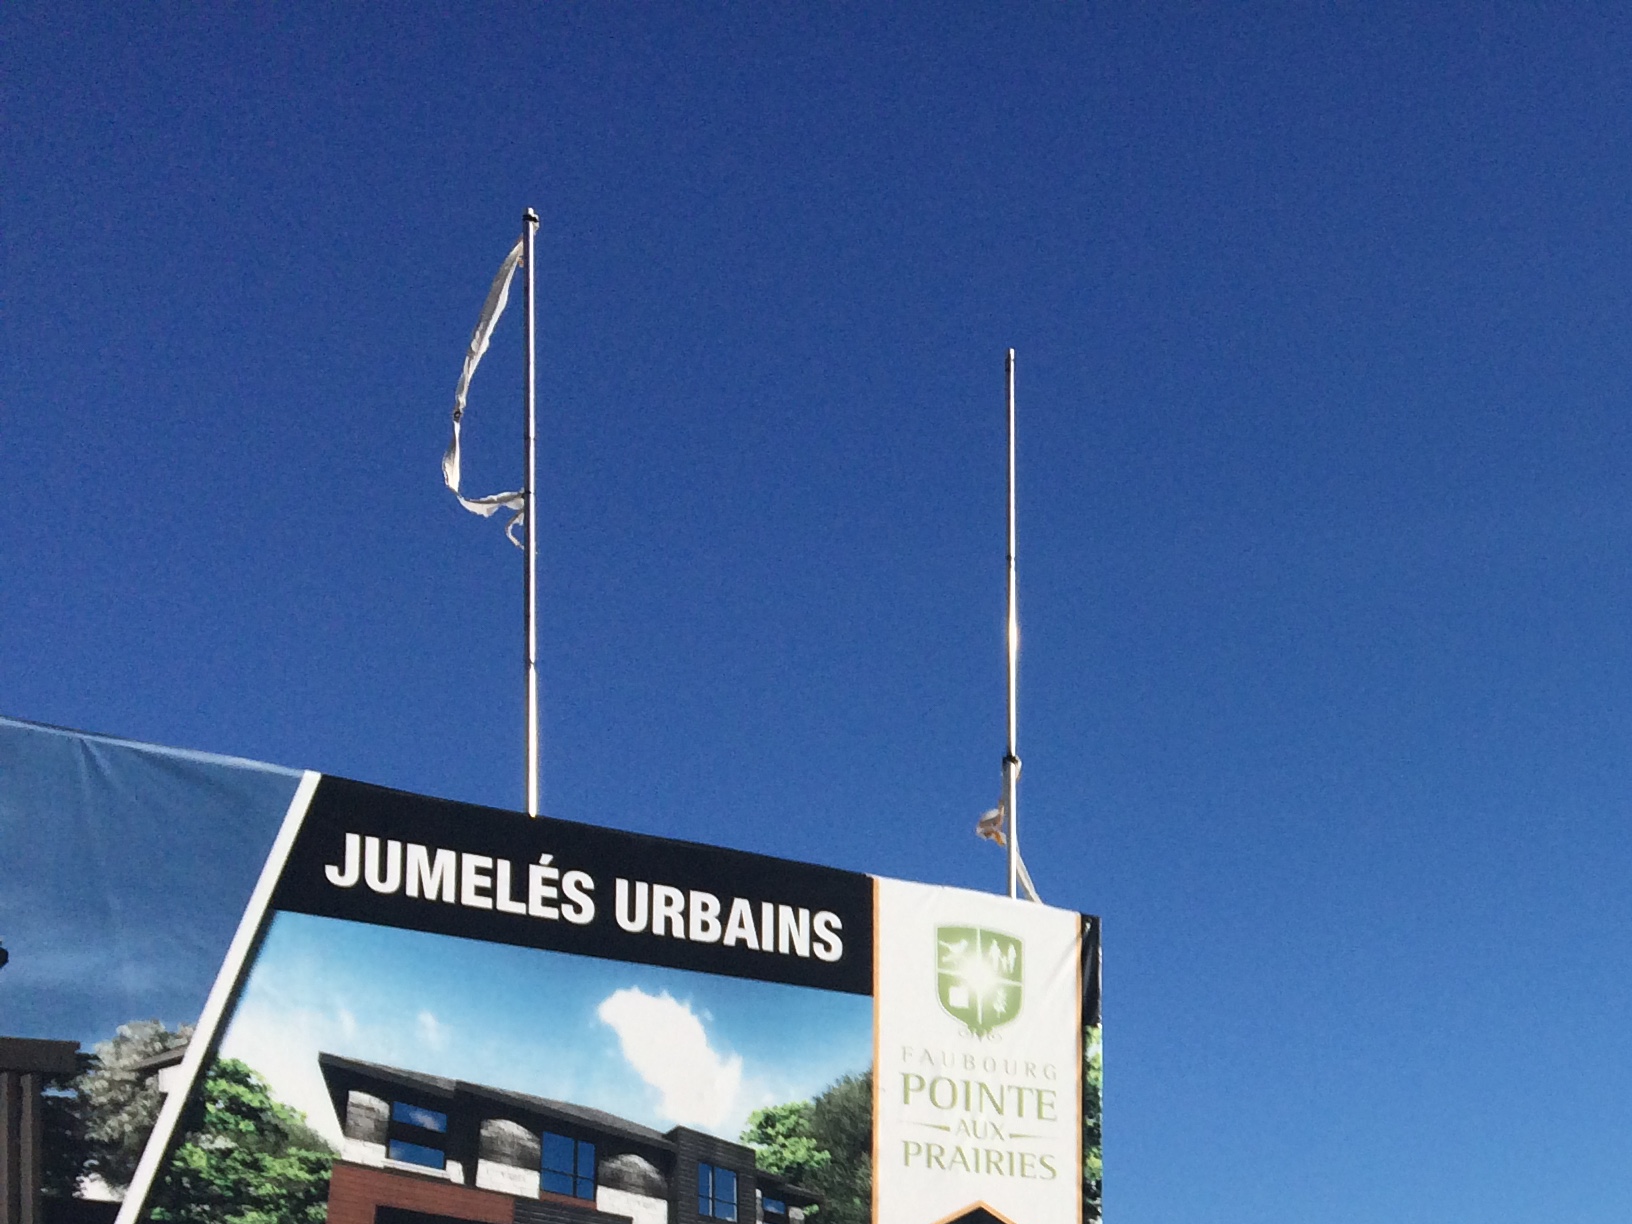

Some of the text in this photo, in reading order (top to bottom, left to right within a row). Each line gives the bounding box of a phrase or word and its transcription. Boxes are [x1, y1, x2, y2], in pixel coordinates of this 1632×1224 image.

[324, 832, 844, 962] JUMELÉS URBAINS
[901, 1045, 1058, 1081] FAUBOURG
[900, 1072, 1058, 1122] POINTE
[955, 1118, 1006, 1142] AUX
[901, 1140, 1058, 1181] PRAIRIES
